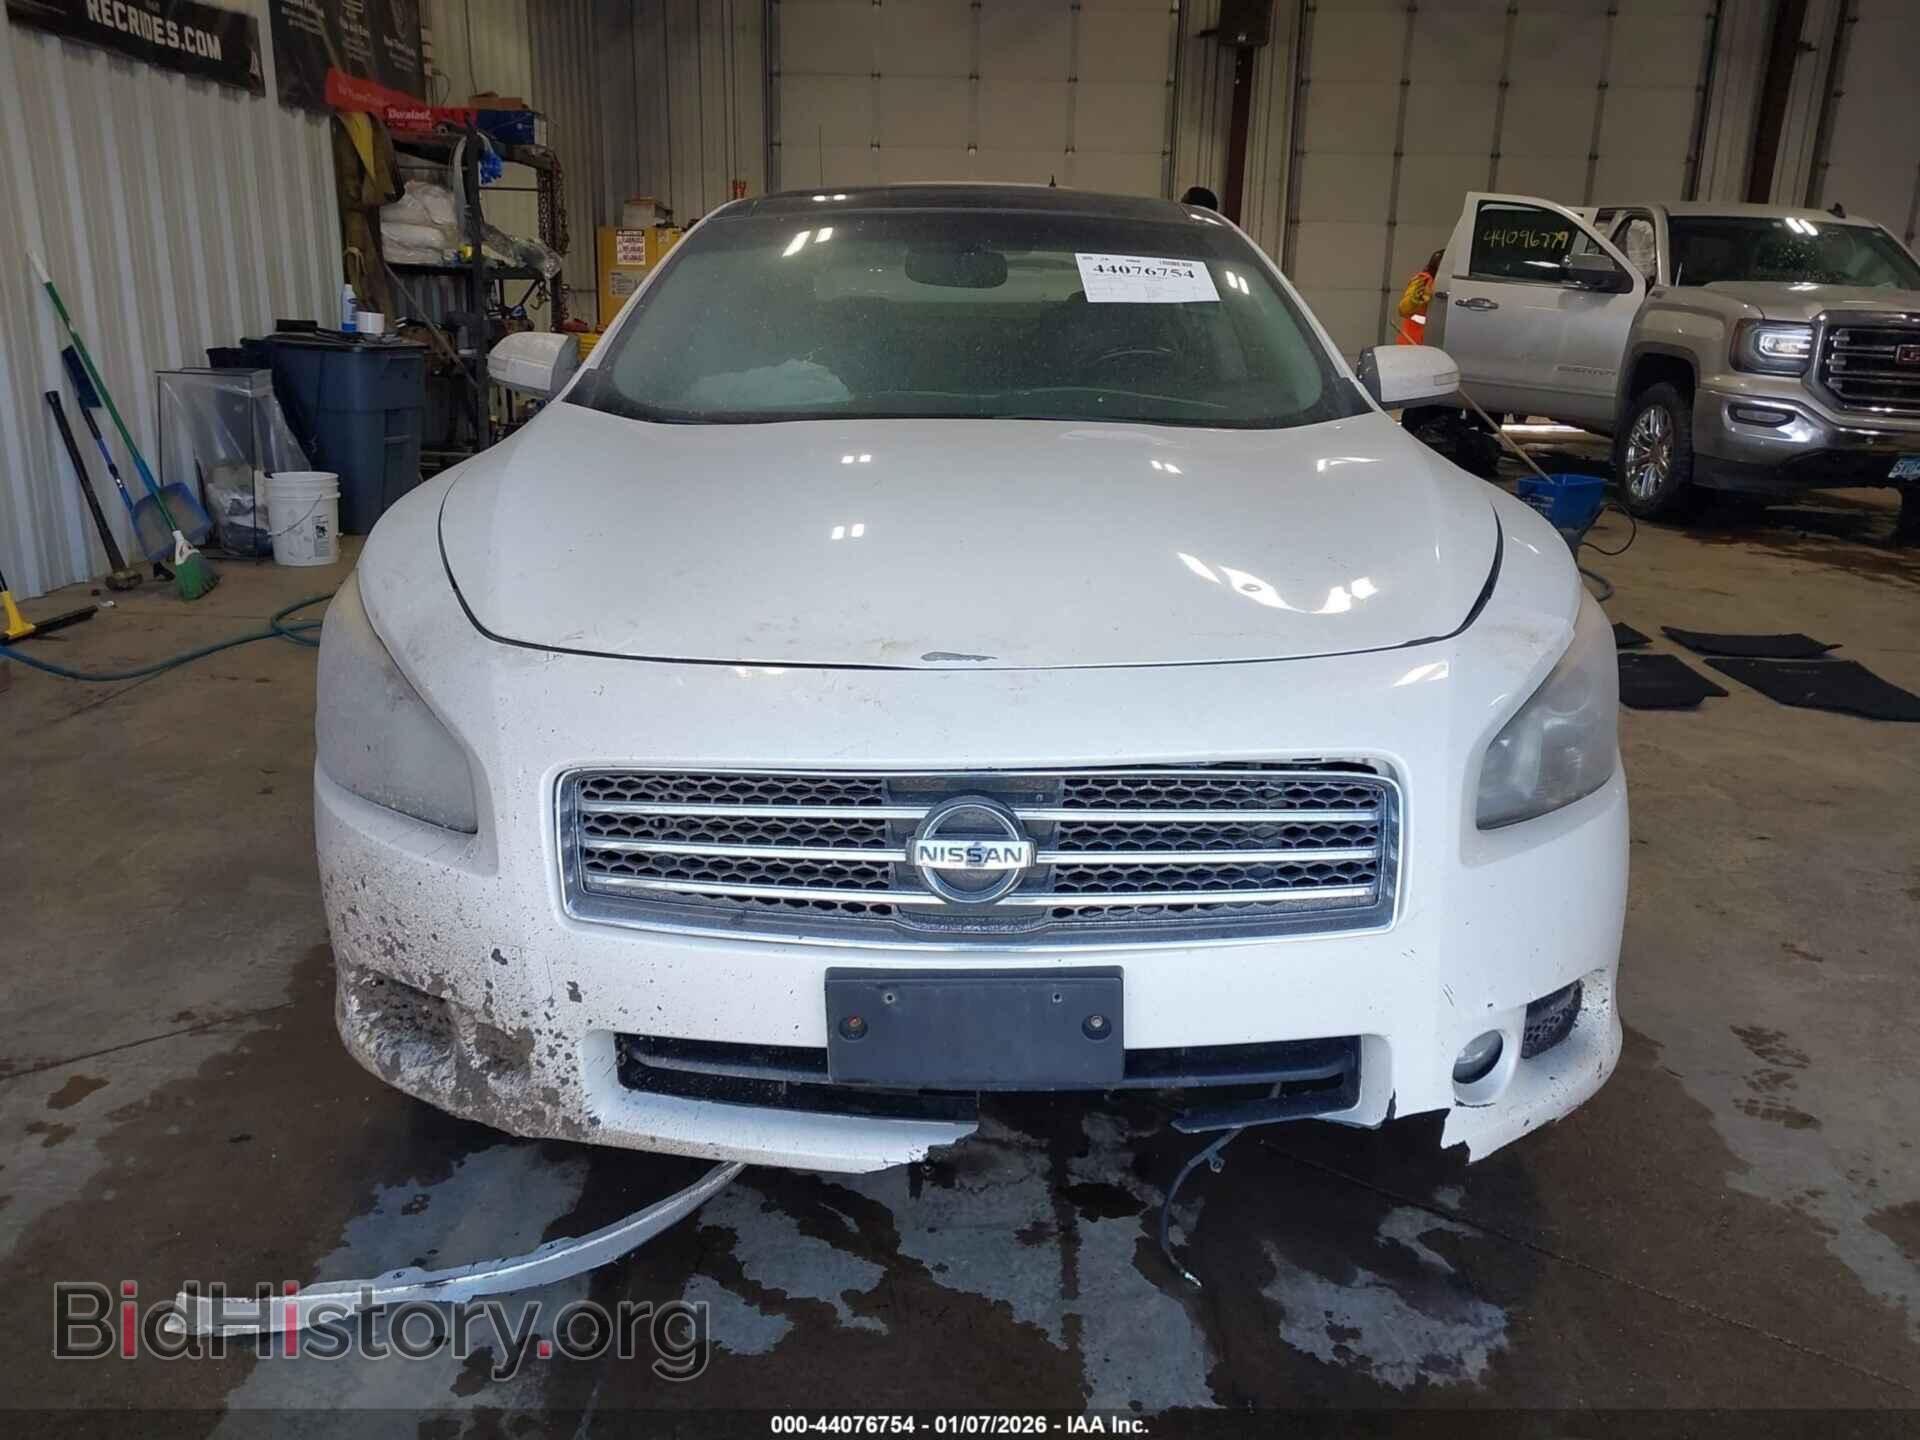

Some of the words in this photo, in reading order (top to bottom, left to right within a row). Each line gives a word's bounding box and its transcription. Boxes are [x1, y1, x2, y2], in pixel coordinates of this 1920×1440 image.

[86, 0, 222, 61] RECRIDES.COM
[1484, 229, 1569, 248] 44096779
[1093, 264, 1195, 279] 44076754
[920, 846, 1022, 863] NISSAN
